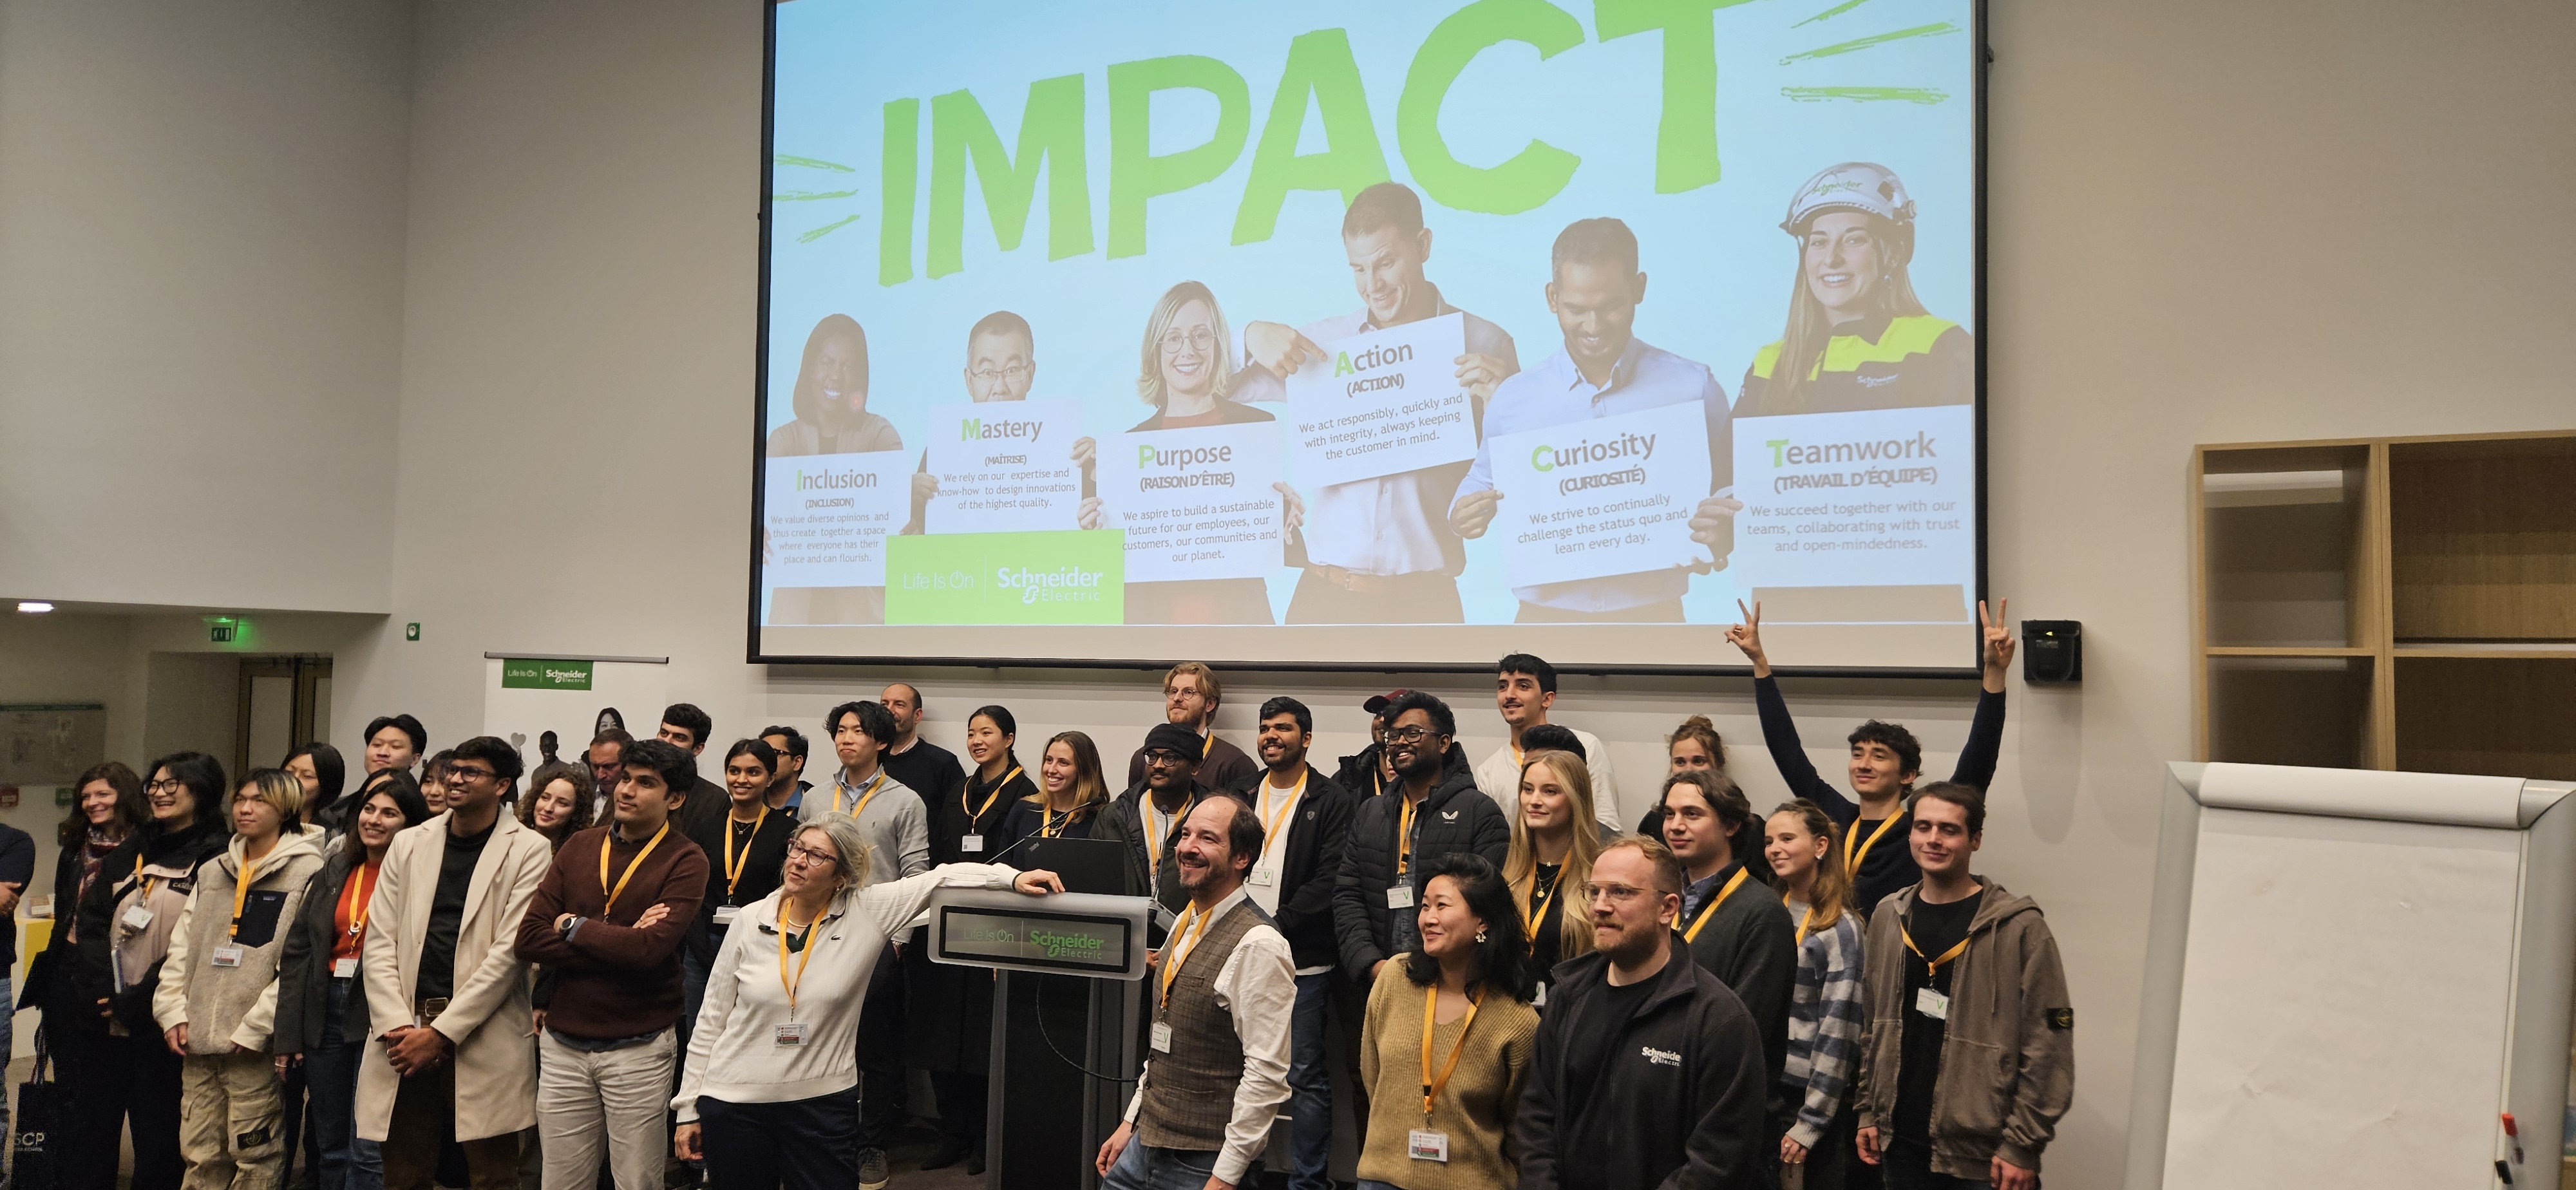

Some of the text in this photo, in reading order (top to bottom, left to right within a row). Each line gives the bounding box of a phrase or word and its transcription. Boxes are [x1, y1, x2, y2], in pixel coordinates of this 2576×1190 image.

[880, 0, 1756, 285] IMPACT
[1334, 344, 1414, 378] Action
[1347, 373, 1405, 398] (ACTION)
[1299, 393, 1463, 434] We act responsibly, quickly and
[961, 418, 1043, 442] Mastery
[1305, 411, 1461, 449] with integrity, always keeping
[1325, 430, 1439, 460] the customer in mind.
[1531, 432, 1656, 472] Curiosity
[1766, 430, 1937, 468] Teamwork
[985, 453, 1027, 467] (MAÎTRISE)
[1138, 444, 1231, 471] Purpose
[797, 469, 877, 491] Inclusion
[944, 473, 957, 482] We
[959, 473, 975, 484] rely
[1010, 469, 1050, 480] expertise
[1054, 468, 1069, 478] and
[1140, 476, 1188, 492] (RAISON
[1559, 464, 1645, 496] (CURIOSITÉ)
[1774, 473, 1849, 494] (TRAVAIL
[937, 482, 1075, 496] know-how to design innovations
[806, 498, 854, 509] (INCLUSION)
[958, 498, 1052, 511] of the highest quality.
[1123, 512, 1137, 521] We
[1141, 509, 1168, 521] aspire
[1171, 508, 1181, 516] to
[1184, 505, 1208, 516] build
[1220, 499, 1274, 513] sustainable
[1529, 493, 1671, 524] We strive to continually
[1750, 500, 1956, 517] We succeed together with our
[771, 515, 782, 524] We
[808, 515, 834, 523] diverse
[837, 513, 869, 524] opinions
[875, 512, 889, 521] and
[1128, 515, 1270, 536] future for our employees, our
[1517, 507, 1688, 544] challenge the status quo and
[1747, 518, 1960, 536] teams, collaborating with trust
[773, 529, 789, 538] thus
[821, 527, 854, 538] together
[864, 527, 886, 536] space
[1122, 529, 1277, 551] customers, our communities and
[1555, 532, 1651, 554] learn every day.
[807, 542, 842, 551] everyone
[844, 540, 857, 549] has
[860, 540, 878, 548] their
[1775, 537, 1927, 553] and open-mindedness.
[784, 555, 804, 565] place
[807, 554, 821, 563] and
[840, 553, 872, 562] flourish.
[1172, 549, 1225, 563] our planet.
[903, 570, 974, 589] Life Is On
[998, 566, 1103, 589] Schneider
[1041, 589, 1101, 601] Electric
[964, 929, 1014, 943] Life Is On
[1030, 930, 1104, 950] Schneider
[1061, 947, 1102, 959] Electric
